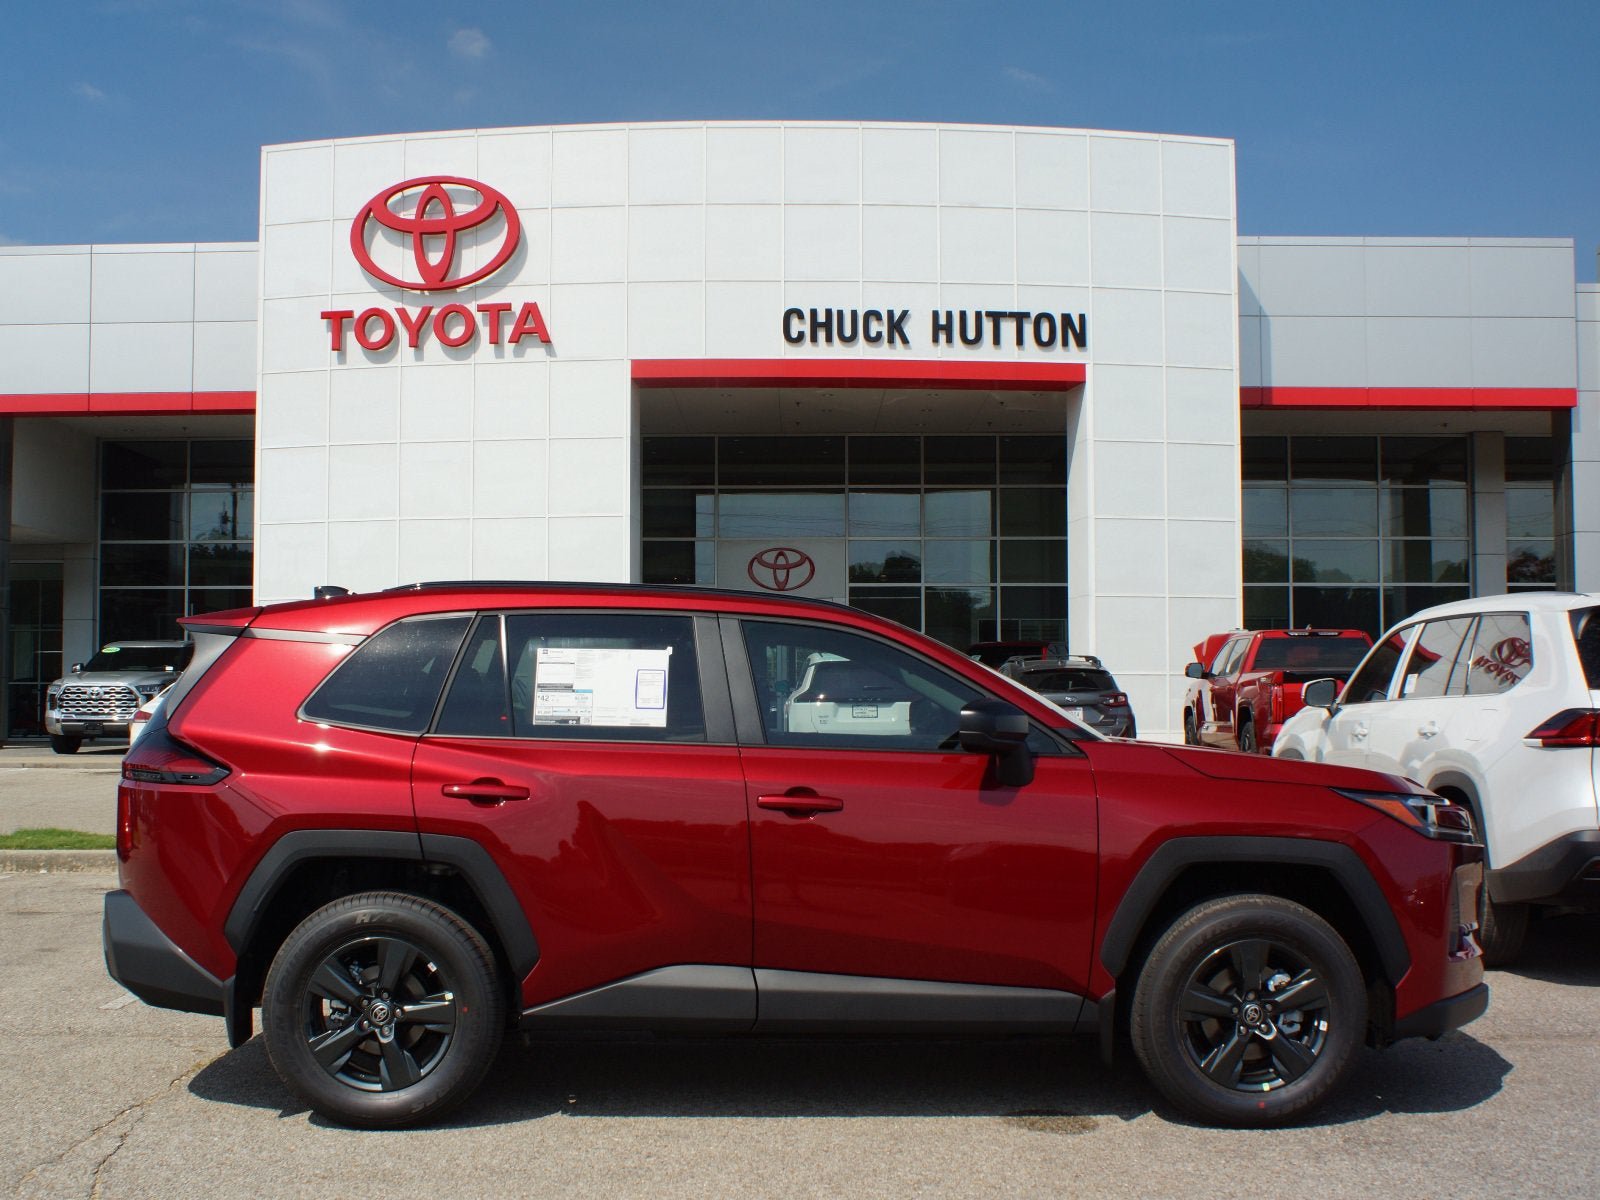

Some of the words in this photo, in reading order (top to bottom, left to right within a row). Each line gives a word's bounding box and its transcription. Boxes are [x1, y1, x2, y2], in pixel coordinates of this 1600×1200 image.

[321, 302, 552, 351] TOYOTA
[783, 307, 910, 344] CHUCK
[932, 310, 1087, 347] HUTTON
